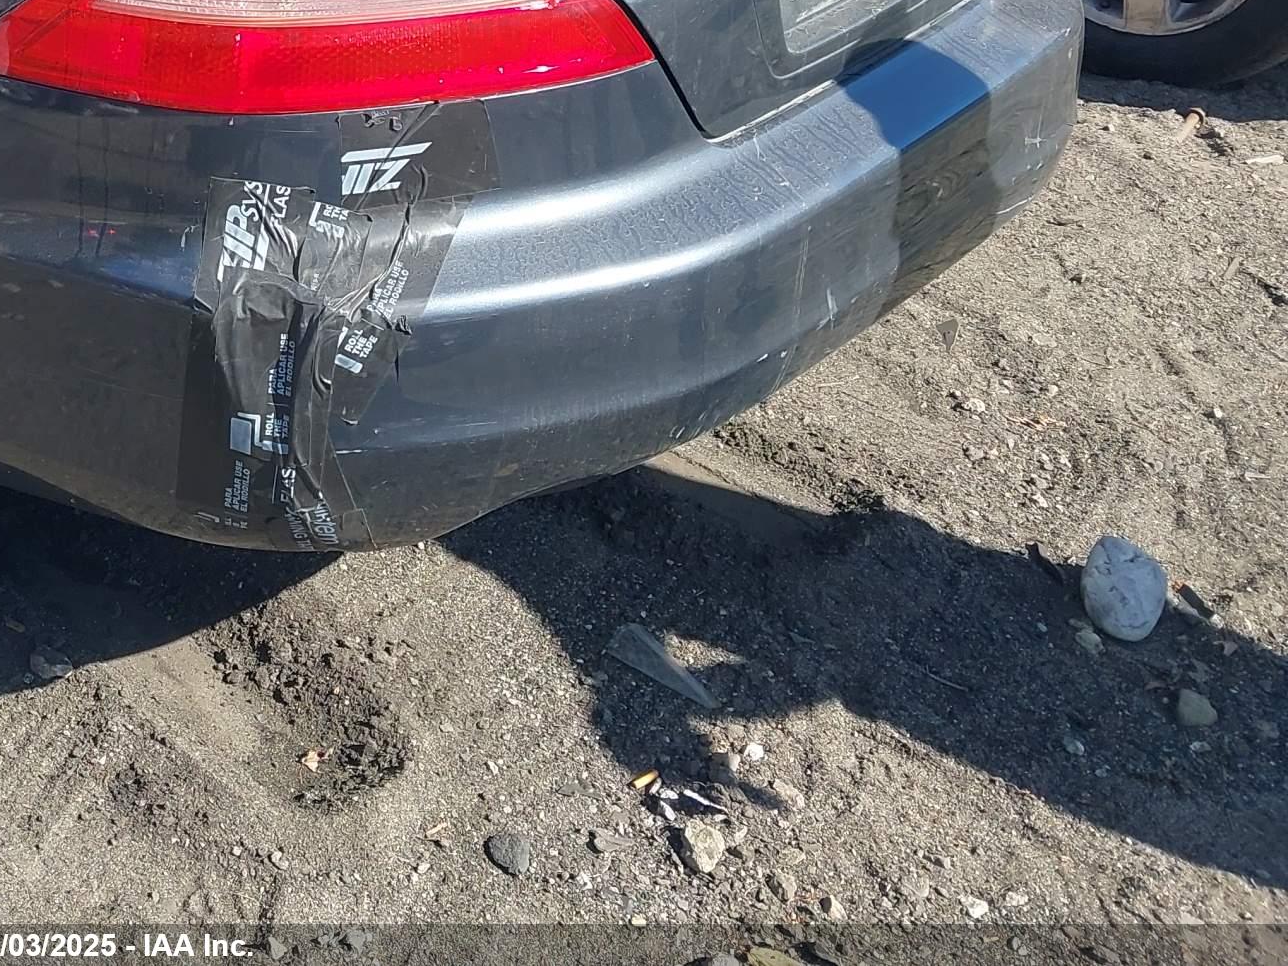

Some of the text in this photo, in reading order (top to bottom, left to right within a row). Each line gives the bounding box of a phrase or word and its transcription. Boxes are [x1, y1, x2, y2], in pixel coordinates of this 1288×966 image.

[392, 260, 404, 279] USE
[389, 269, 409, 306] RODILLO
[344, 329, 363, 352] ROLL
[352, 336, 367, 354] THE
[359, 334, 378, 358] TAPE
[277, 355, 287, 395] APLICAR
[285, 340, 295, 397] EL RODILLO
[265, 412, 275, 436] ROLL
[273, 418, 283, 438] THE
[224, 487, 233, 508] PARA
[232, 460, 243, 511] APLICAR USE
[240, 468, 251, 513] EL RODILLO
